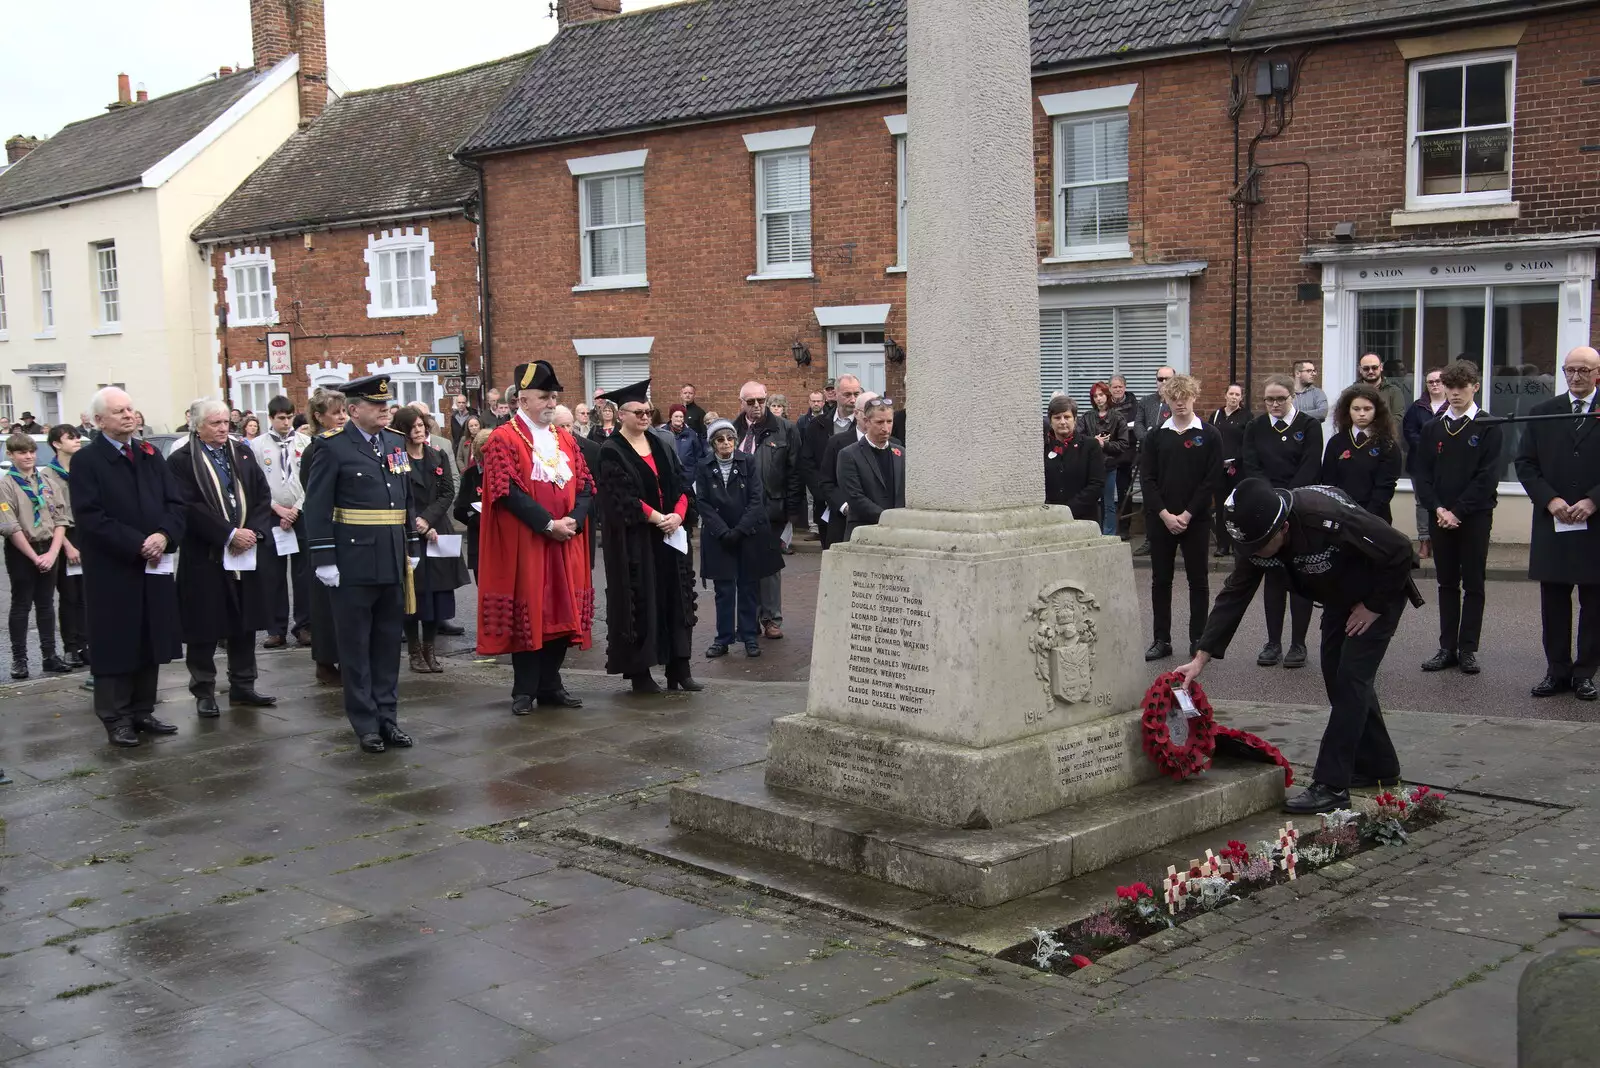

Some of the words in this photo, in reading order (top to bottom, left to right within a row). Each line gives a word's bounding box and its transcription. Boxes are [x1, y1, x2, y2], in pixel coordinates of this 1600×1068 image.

[1444, 265, 1477, 274] SALON
[1520, 260, 1554, 270] SALON
[1374, 269, 1404, 278] SALON
[428, 359, 436, 370] P
[449, 360, 458, 369] WC
[1308, 562, 1330, 573] POLICE
[852, 570, 868, 578] DAVID
[871, 572, 904, 582] THORNDYKE
[852, 580, 876, 589] WILLIAM
[879, 583, 910, 592] THORNDYKE
[852, 591, 873, 600] DUDLEY
[876, 594, 899, 603] OSWALD
[902, 596, 923, 606] THORN
[852, 601, 876, 611] DOUGLAS
[880, 605, 903, 614] HERBERT
[851, 612, 878, 622] LEONARD
[881, 616, 900, 624] JAMES
[902, 618, 922, 627] TUFFS
[850, 622, 872, 632] WALTER
[875, 625, 898, 635] EDWARD
[900, 629, 912, 638] VINE
[850, 633, 872, 642] ARTHUR
[874, 636, 900, 646] LEONARD
[904, 640, 930, 650] WATKINS
[850, 644, 872, 652] WILLIAM
[876, 647, 900, 656] WATLING
[850, 654, 870, 664] ARTHUR
[873, 658, 899, 668] CHARLES
[902, 662, 930, 672] WEAVERS
[848, 664, 878, 676] FREDERICK
[880, 669, 906, 680] WEAVERS
[848, 675, 870, 684] WILLIAM
[872, 679, 892, 688] ARTHUR
[895, 682, 936, 696] WHISTLECRAFT
[848, 685, 868, 695] CLAUDE
[872, 689, 896, 700] RUSSELL
[900, 694, 922, 704] WRIGHT
[1094, 691, 1112, 708] 1918
[848, 696, 869, 705] GERALD
[872, 700, 896, 710] CHARLES
[900, 704, 922, 714] WRIGHT
[1024, 710, 1044, 724] 1914
[1057, 740, 1083, 751] VALENTINE
[1058, 753, 1076, 764] ROBERT
[852, 764, 875, 774] HAROLD
[1062, 774, 1082, 786] CHARLES
[1085, 770, 1102, 779] DONALD
